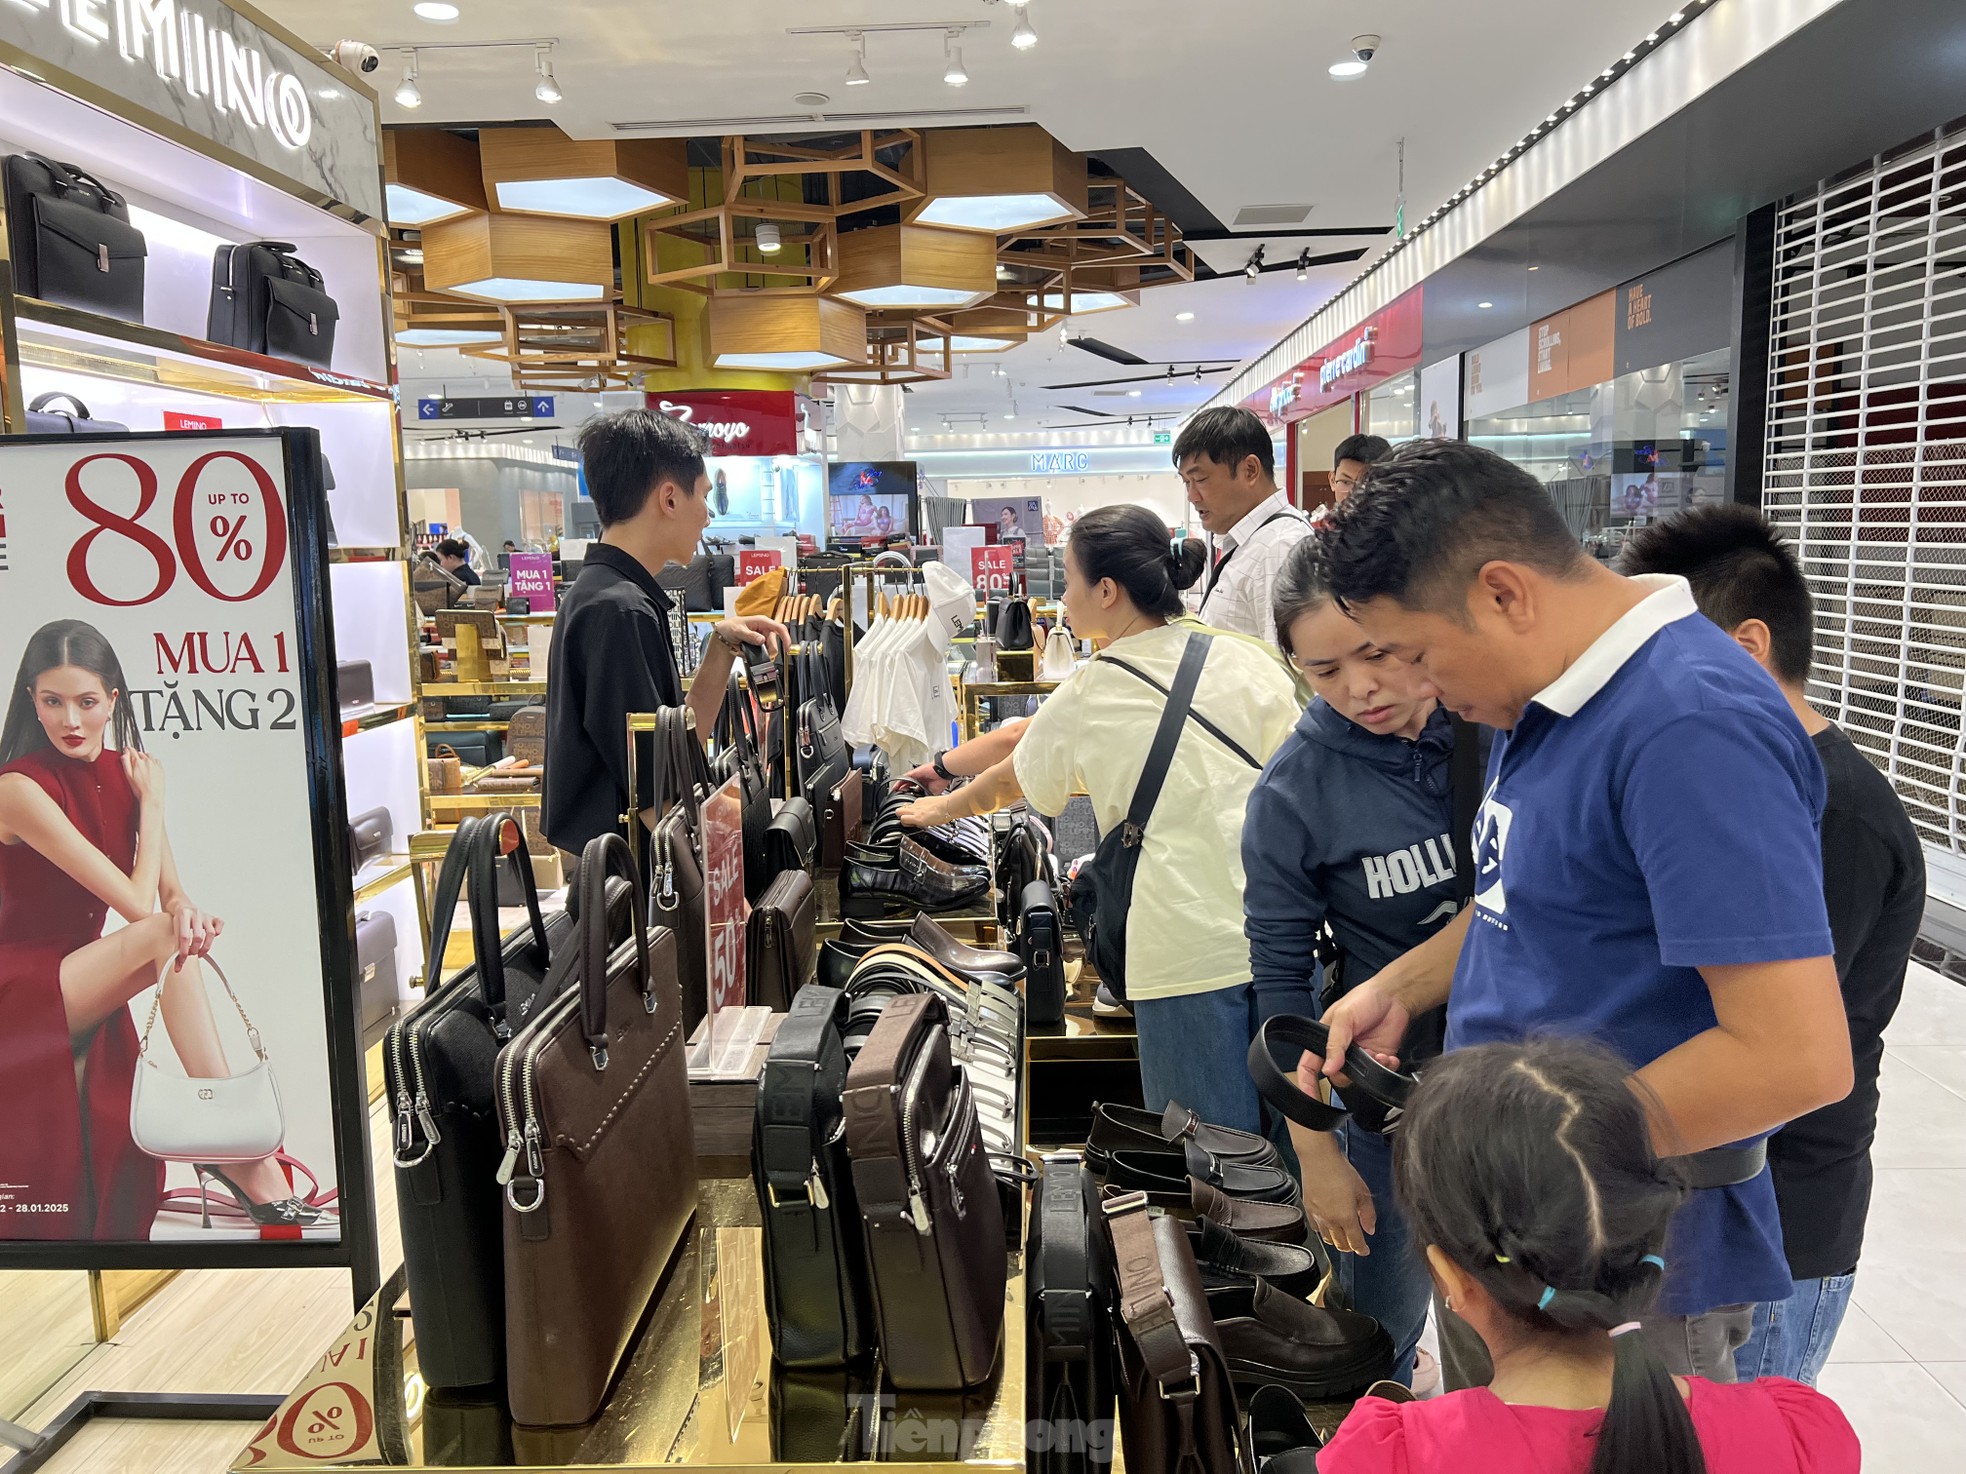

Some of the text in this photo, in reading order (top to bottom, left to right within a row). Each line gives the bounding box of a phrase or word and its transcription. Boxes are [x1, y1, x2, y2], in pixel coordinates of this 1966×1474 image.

[0, 0, 312, 148] EMINO
[180, 419, 207, 430] LEMINO
[1031, 452, 1088, 472] MARC
[208, 493, 249, 505] UP TO
[65, 451, 287, 607] 80
[978, 560, 1006, 570] SALE
[516, 570, 547, 580] MUA 1
[515, 580, 551, 594] TẶNG 1
[153, 631, 289, 674] MUA 1
[130, 680, 296, 739] TẶNG 2
[713, 842, 739, 906] SALE
[16, 1203, 69, 1213] 28.01.2025
